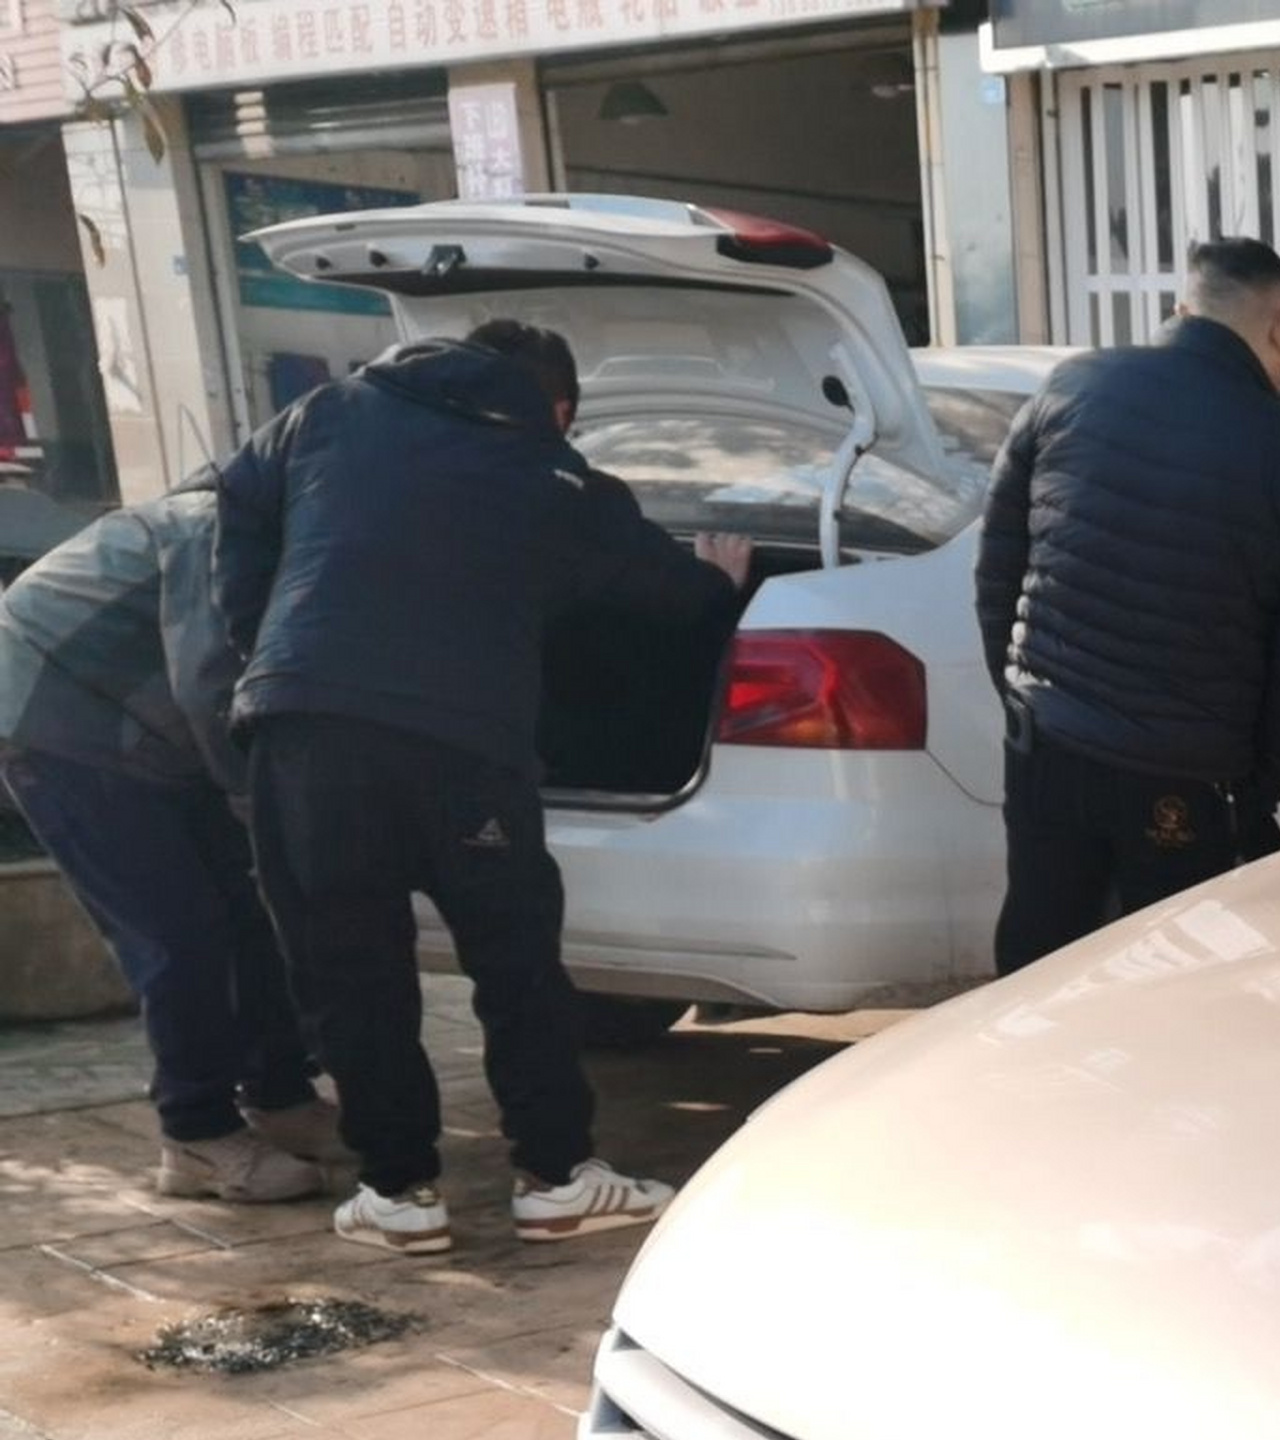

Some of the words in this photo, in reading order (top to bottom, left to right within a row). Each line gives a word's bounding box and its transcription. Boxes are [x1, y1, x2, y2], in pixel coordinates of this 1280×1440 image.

[272, 6, 374, 60] 编程匹配
[389, 0, 529, 48] 自动变速箱
